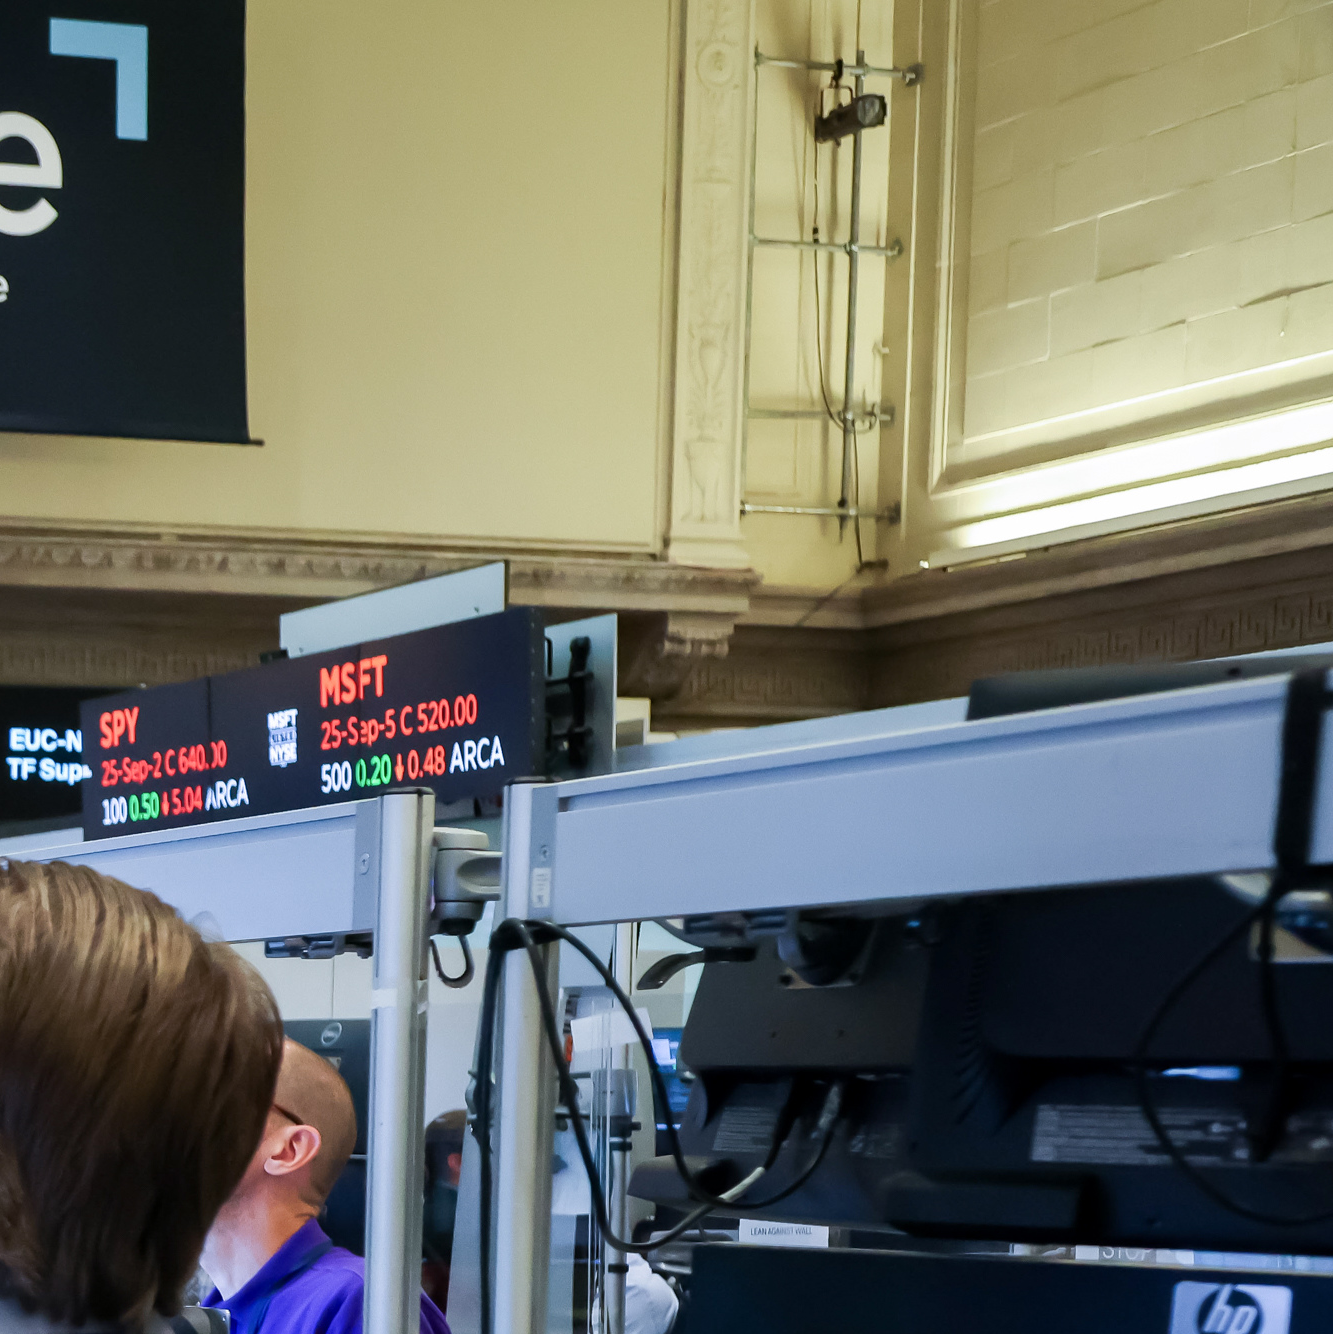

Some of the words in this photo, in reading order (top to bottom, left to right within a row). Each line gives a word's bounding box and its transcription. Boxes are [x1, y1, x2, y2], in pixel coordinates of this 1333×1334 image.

[319, 653, 389, 708] MSFT
[99, 705, 141, 750] SPY
[399, 705, 414, 737] C
[416, 692, 478, 735] 520.00
[8, 726, 83, 753] EUC-N
[164, 747, 177, 777] C
[5, 756, 37, 782] TF
[320, 759, 353, 795] 500
[355, 752, 393, 789] 0.20
[406, 744, 447, 782] 0.48
[448, 734, 506, 775] ARCA
[100, 795, 129, 826] 100
[128, 790, 161, 822] 0.50
[171, 784, 204, 815] 5.04
[204, 776, 250, 812] ARCA
[750, 1227, 767, 1236] LEAN
[767, 1227, 794, 1236] AGAINST
[795, 1226, 812, 1235] WALL
